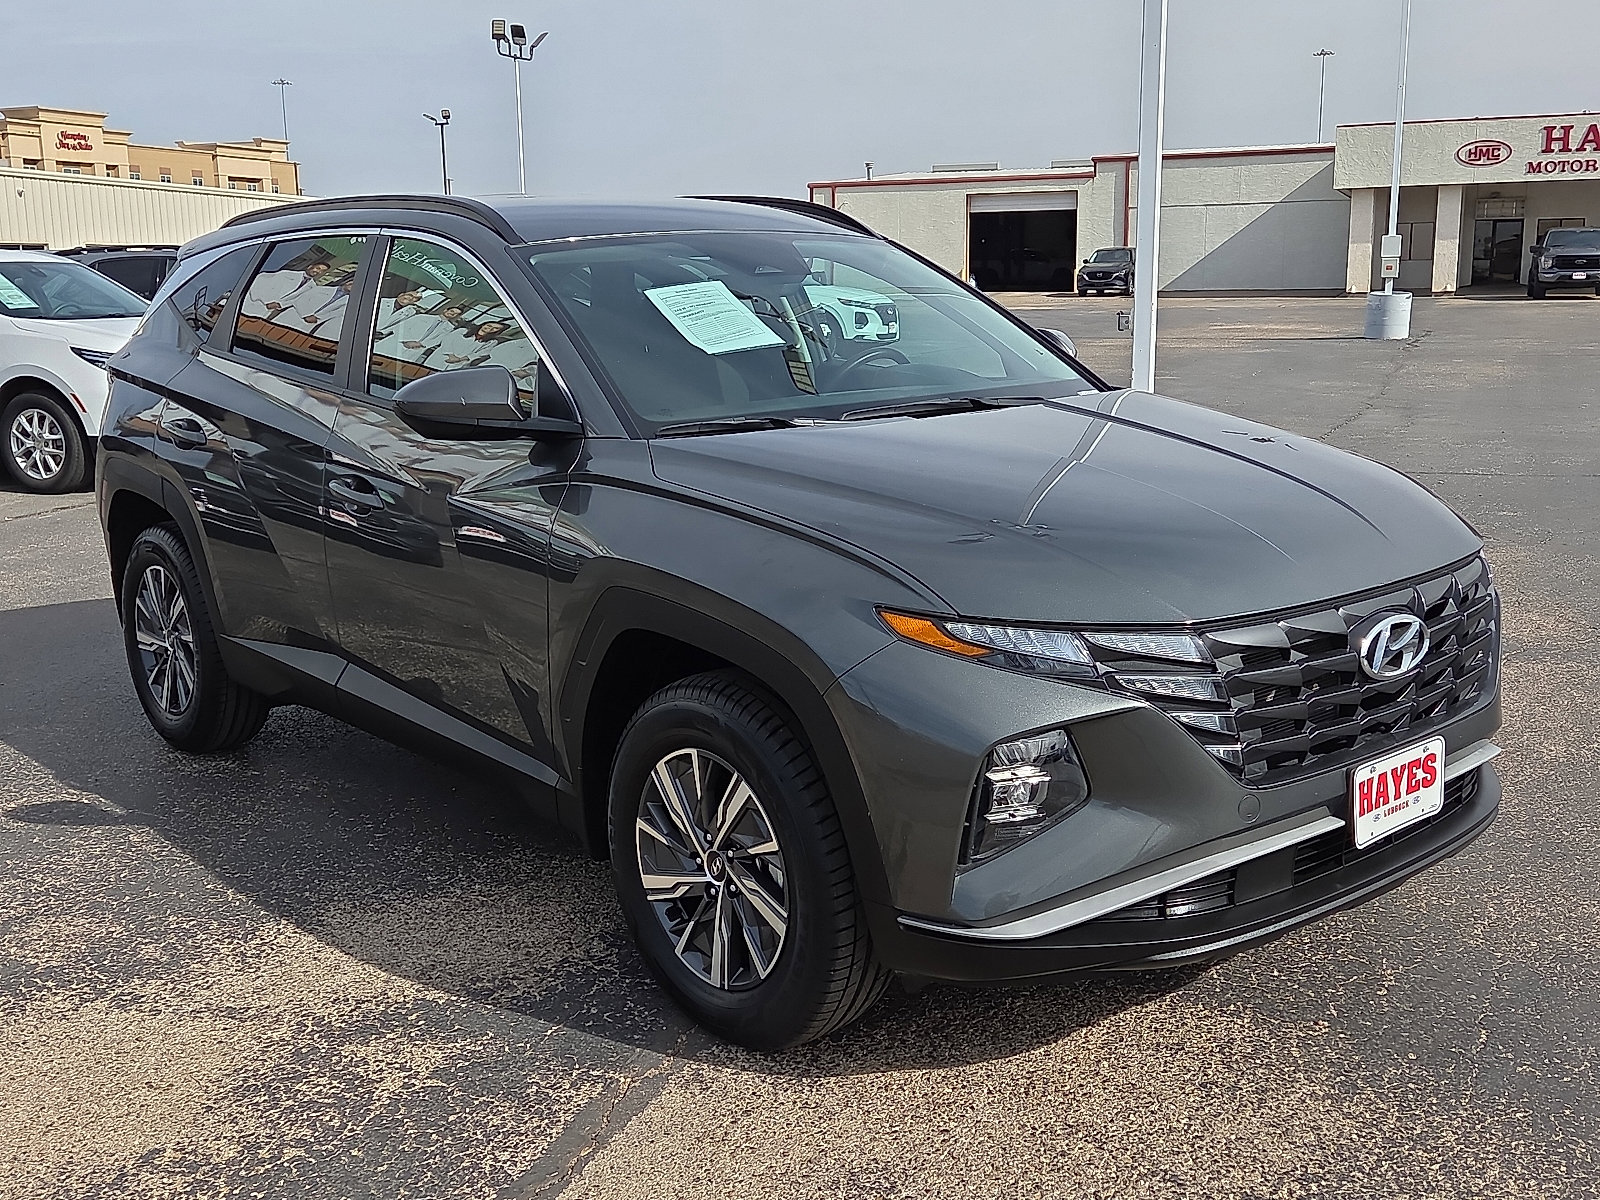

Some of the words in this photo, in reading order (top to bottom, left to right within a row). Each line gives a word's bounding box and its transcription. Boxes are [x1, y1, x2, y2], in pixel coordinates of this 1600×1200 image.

[1467, 144, 1502, 161] HMC
[1526, 159, 1599, 174] MOTOR
[1359, 753, 1437, 818] HAYES
